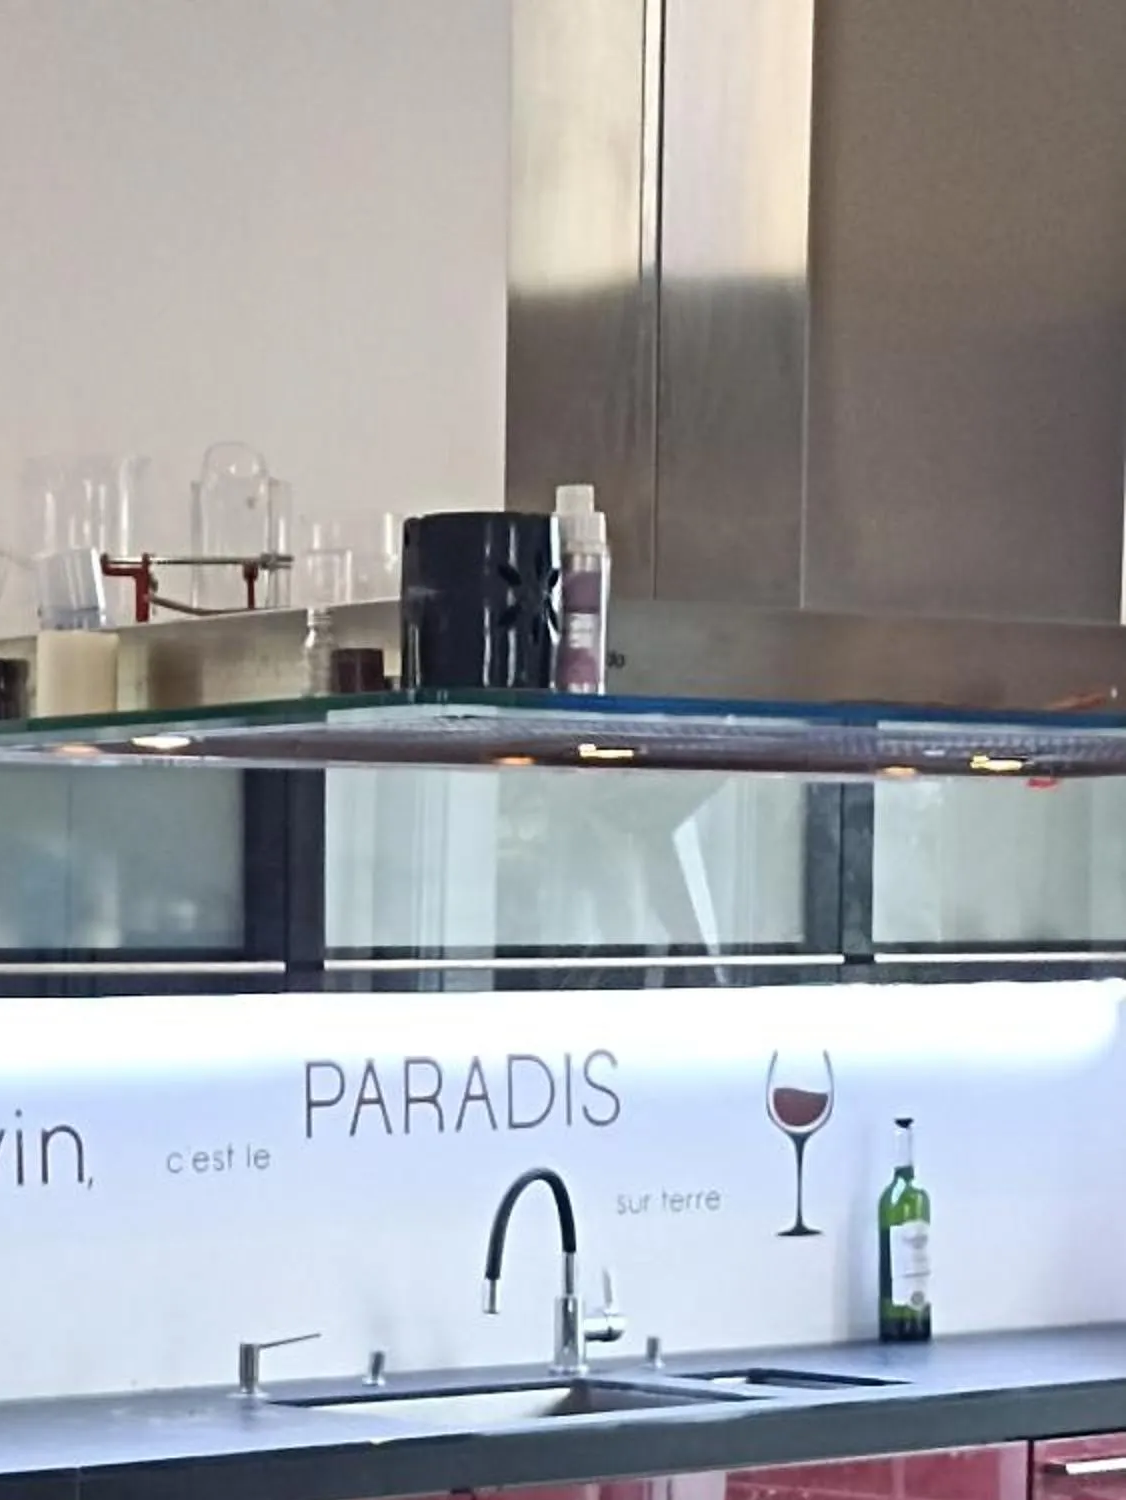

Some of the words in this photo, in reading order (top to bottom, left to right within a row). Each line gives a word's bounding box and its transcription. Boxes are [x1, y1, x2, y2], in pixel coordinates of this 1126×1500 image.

[304, 1049, 622, 1139] PARADIS
[166, 1142, 234, 1174] c'est
[246, 1143, 271, 1171] le
[617, 1193, 651, 1216] sur
[661, 1187, 721, 1213] terre
